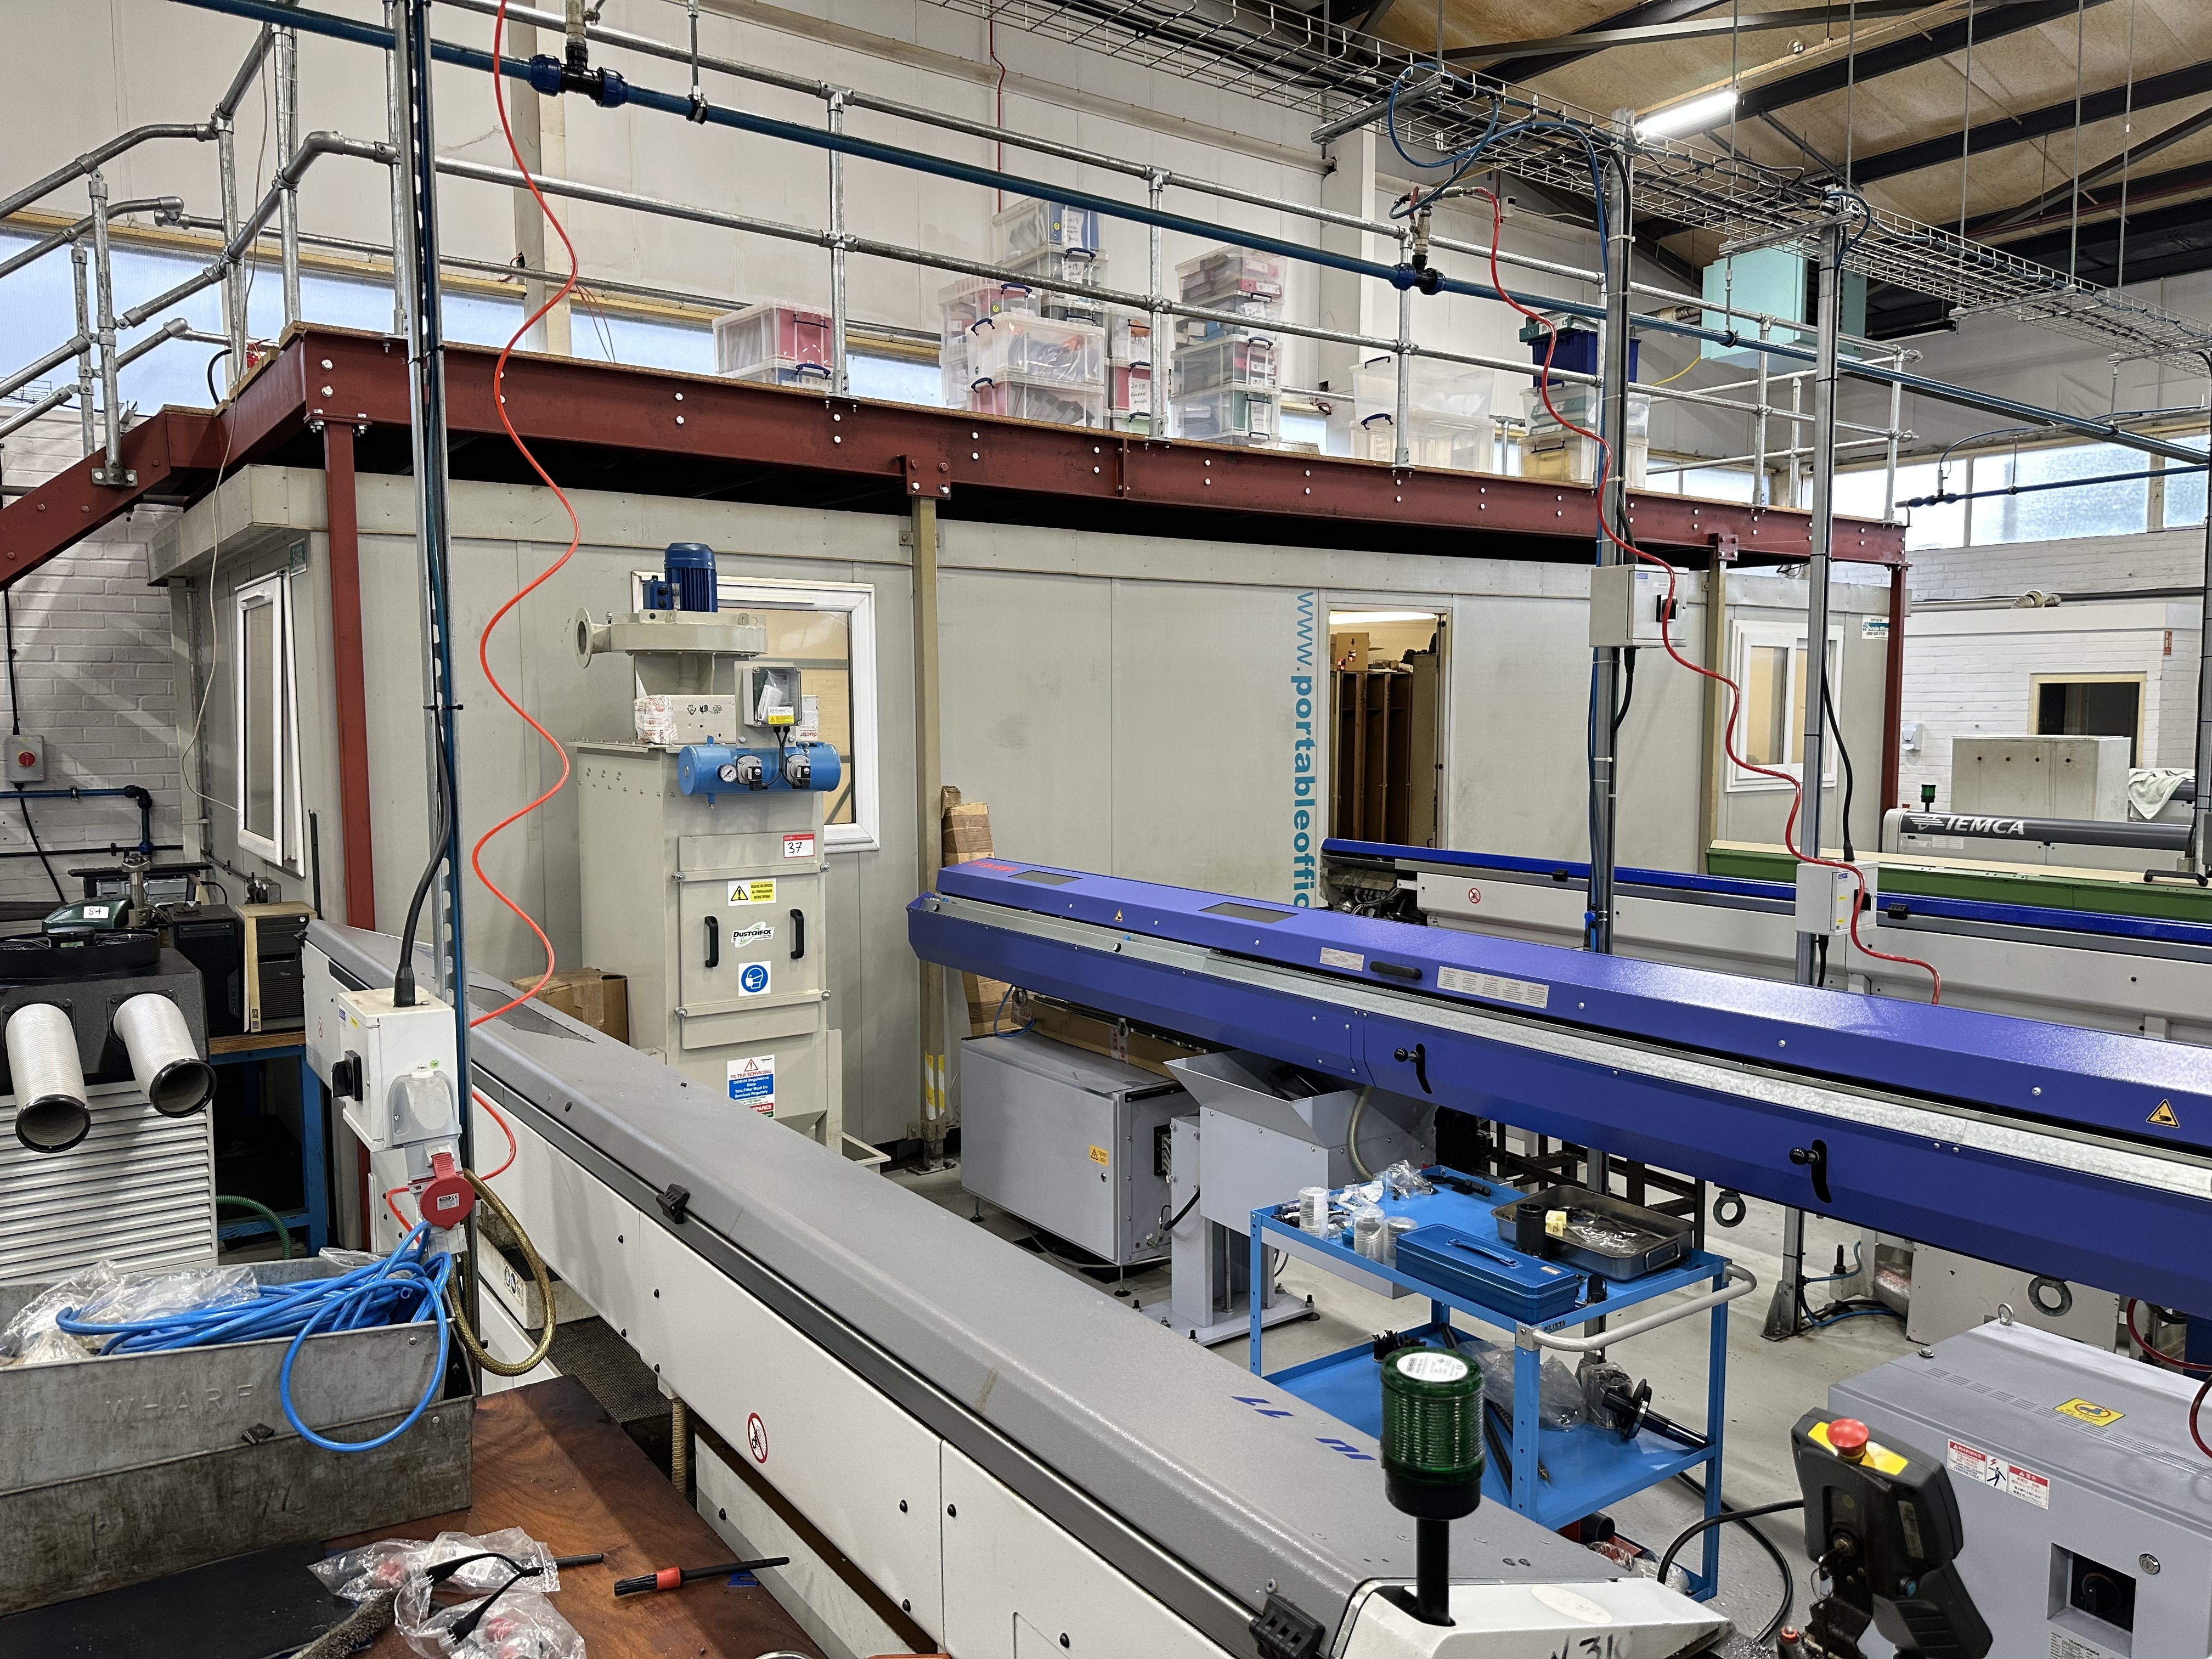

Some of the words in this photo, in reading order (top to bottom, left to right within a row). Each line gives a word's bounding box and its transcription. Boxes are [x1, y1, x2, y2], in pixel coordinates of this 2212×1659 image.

[1247, 308, 1261, 316] 2016
[787, 842, 803, 854] 37
[733, 929, 771, 938] DUSTCHECK
[1549, 1321, 1566, 1331] LISTA
[106, 1384, 253, 1422] WHARF
[1958, 1446, 1982, 1459] WARNING
[2068, 1639, 2100, 1656] TRANSFORMER
